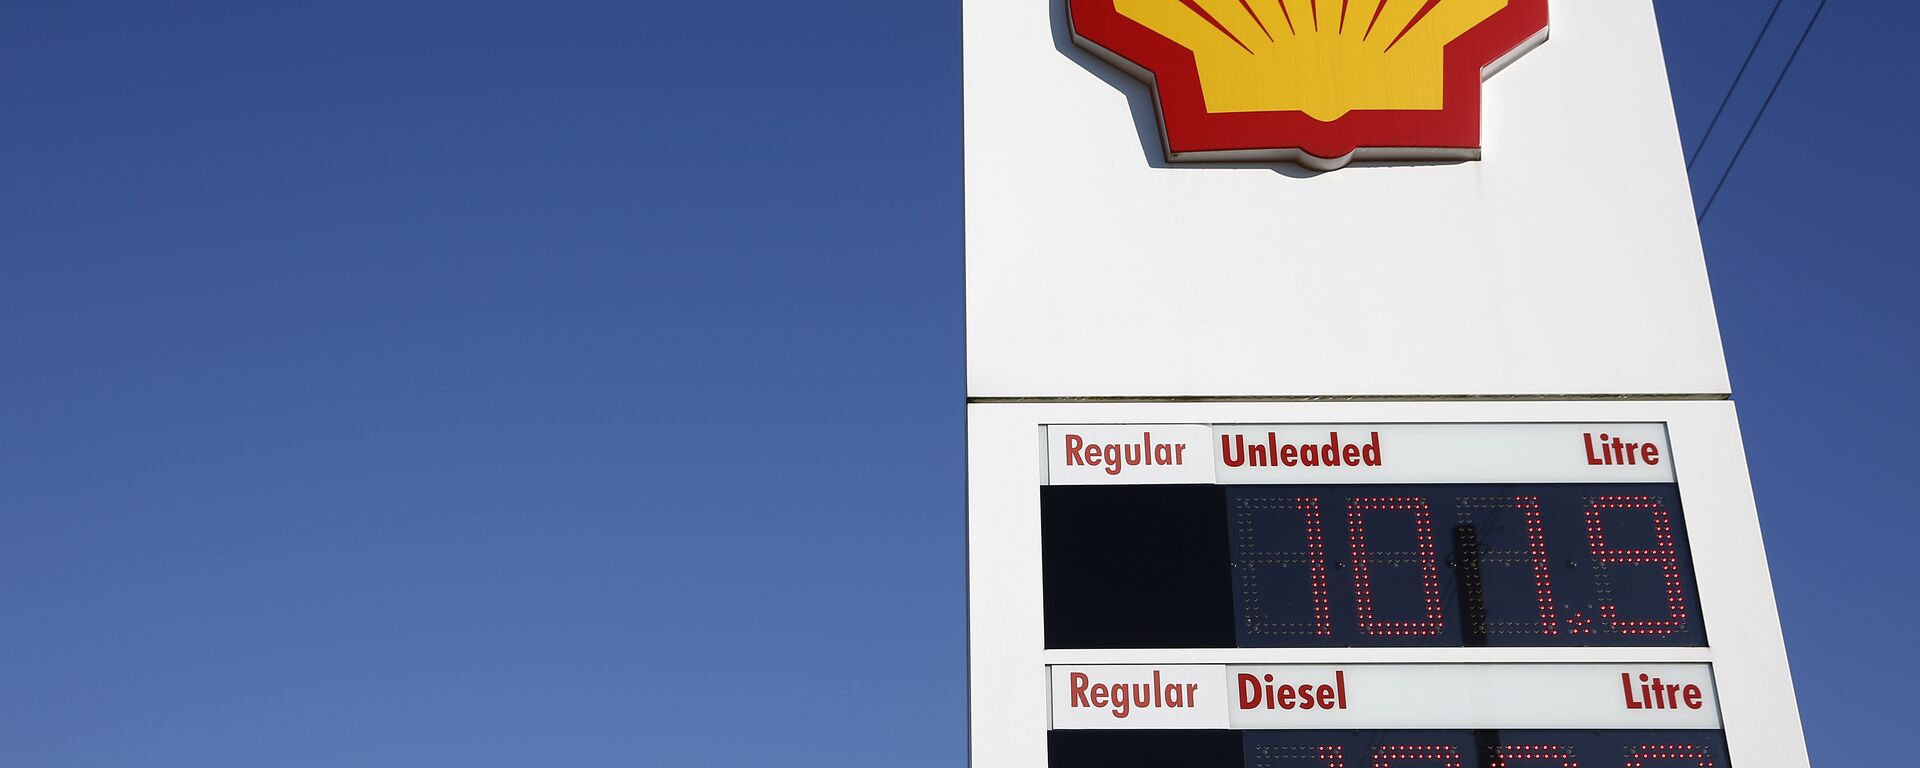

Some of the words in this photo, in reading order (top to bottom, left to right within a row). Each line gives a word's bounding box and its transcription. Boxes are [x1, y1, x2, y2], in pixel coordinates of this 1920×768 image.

[1065, 432, 1186, 476] Regular
[1221, 431, 1382, 467] Unleaded
[1583, 432, 1660, 466] Litre
[1070, 670, 1198, 718] Regular
[1237, 670, 1347, 710] Diesel
[1622, 672, 1703, 710] Litre
